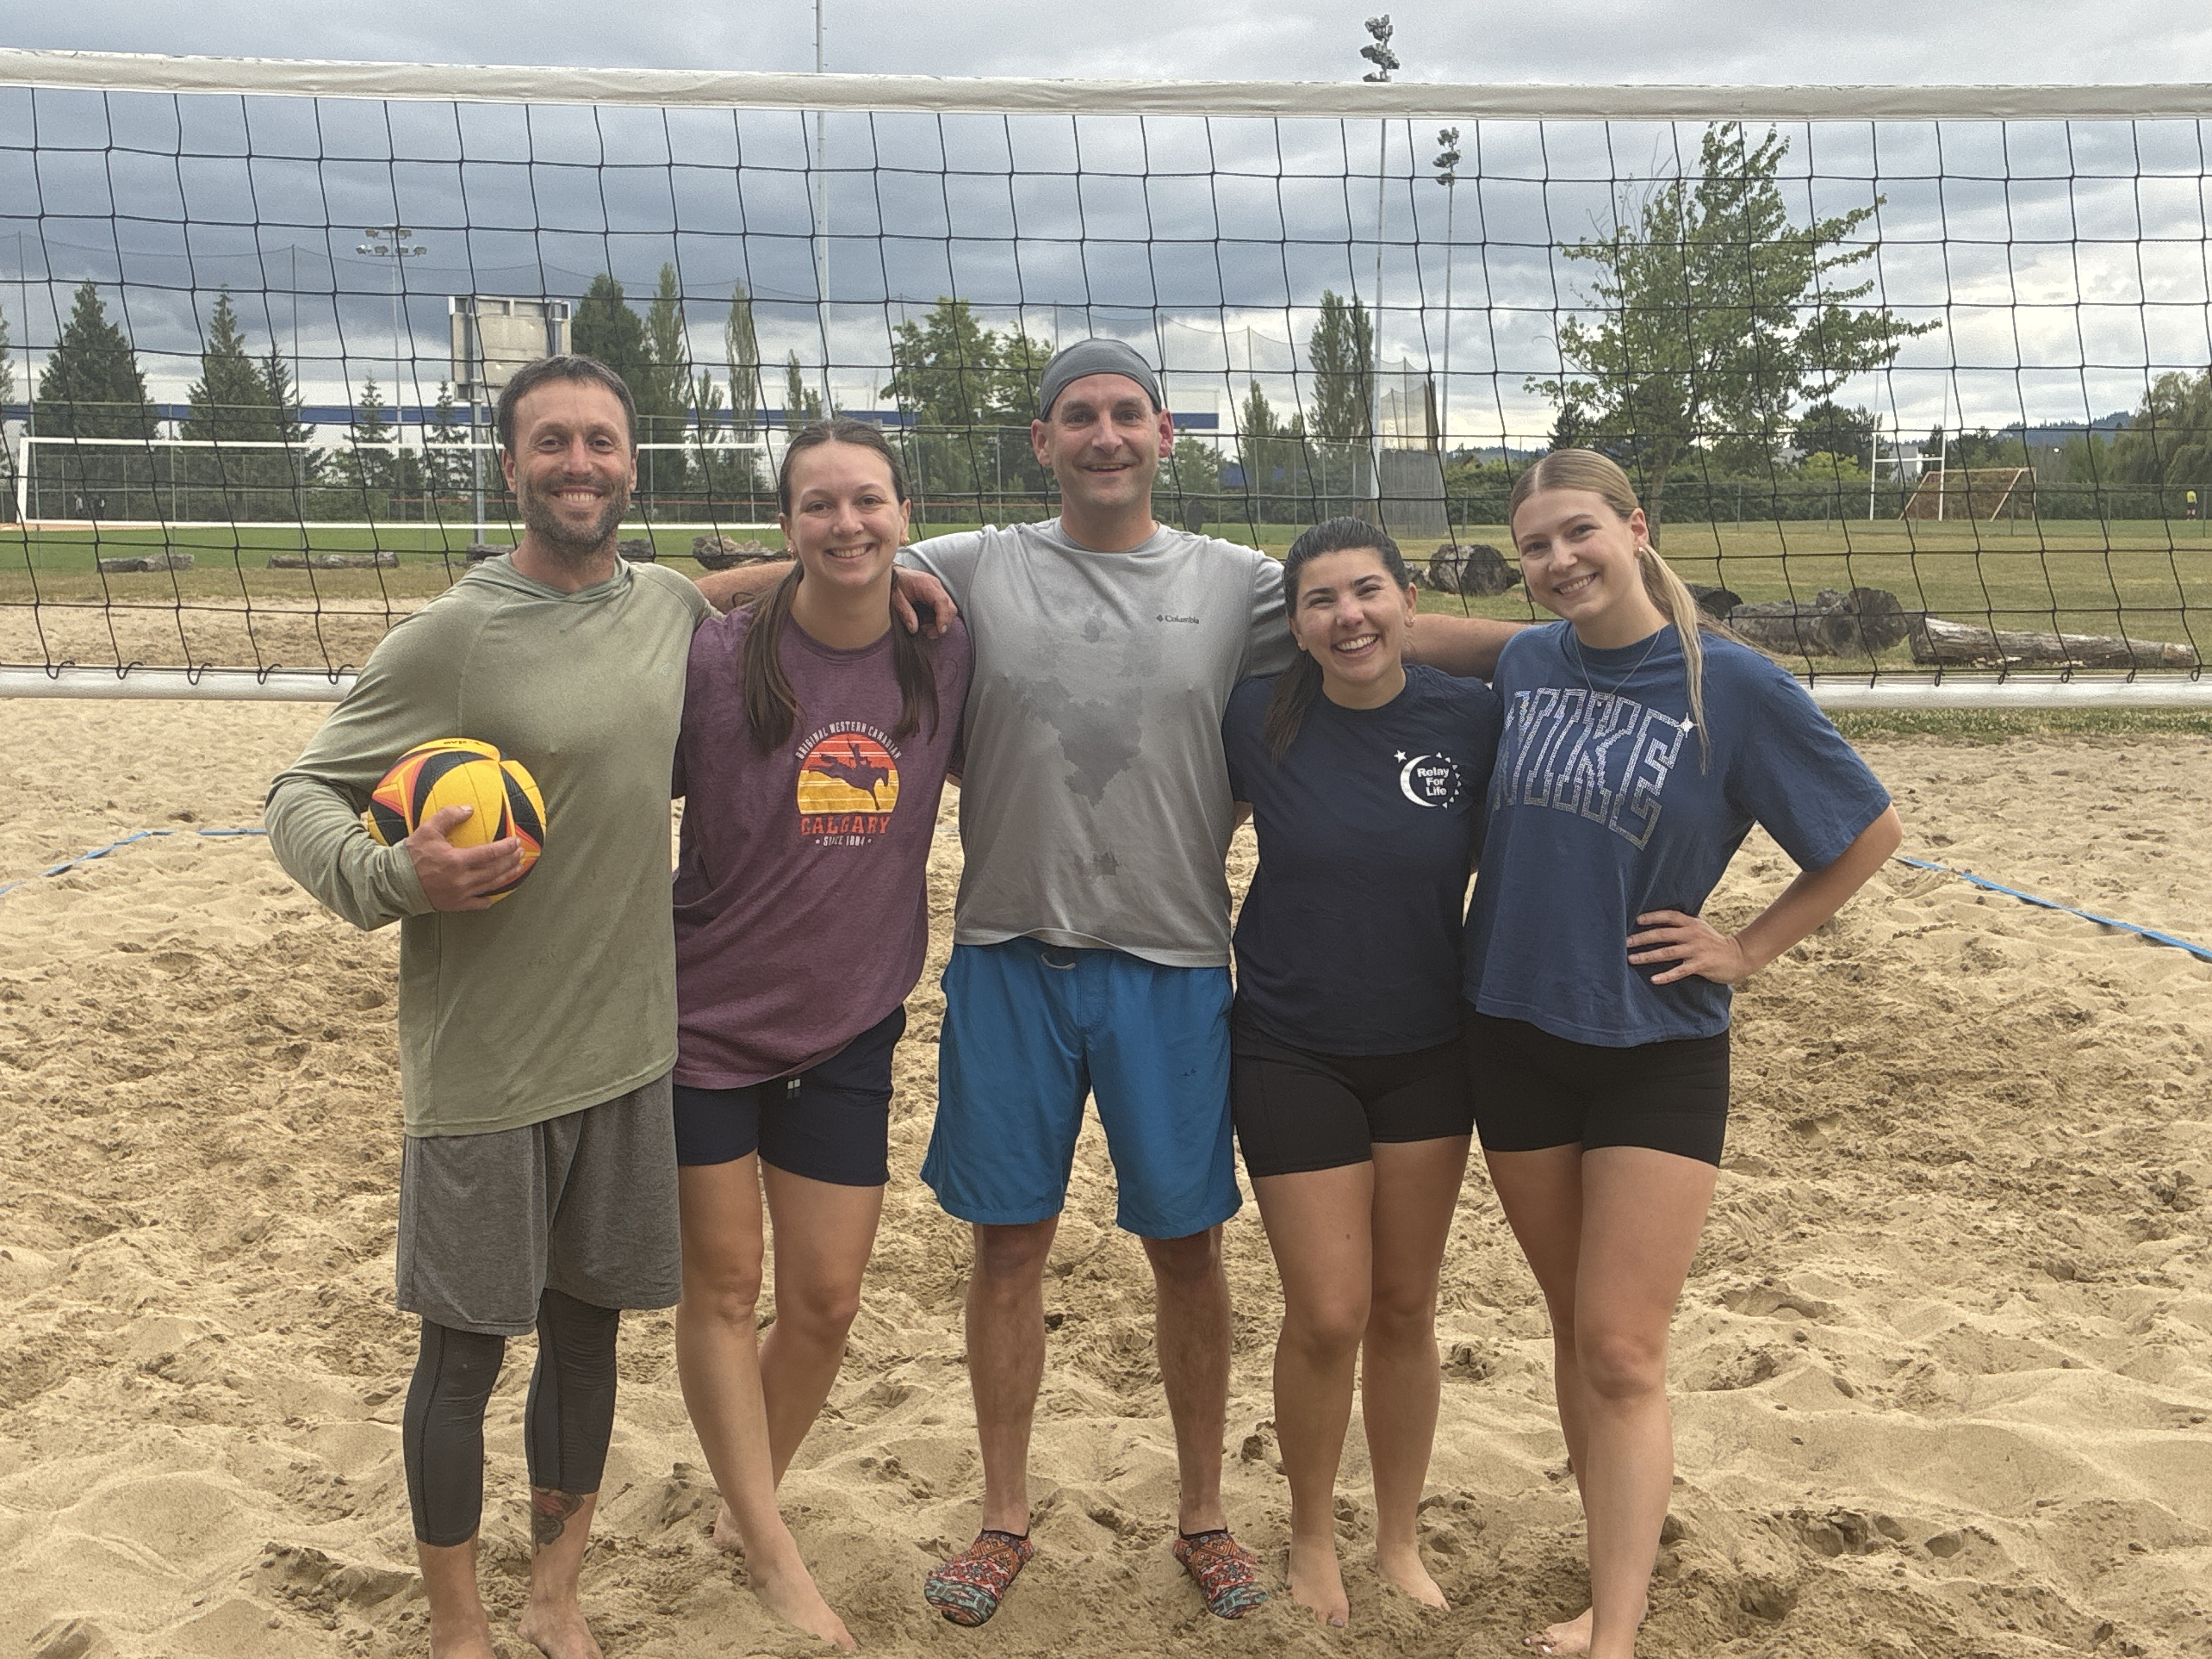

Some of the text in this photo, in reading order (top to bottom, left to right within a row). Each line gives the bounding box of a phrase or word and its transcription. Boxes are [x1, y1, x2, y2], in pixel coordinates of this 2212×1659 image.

[1165, 614, 1200, 624] Columbia
[795, 720, 901, 759] ORIGINAL WESTERN CANADIAN
[1417, 766, 1449, 778] Relay
[1426, 777, 1445, 786] For
[1426, 786, 1447, 797] Life
[800, 815, 891, 836] CALGARY
[823, 835, 844, 847] SINCE
